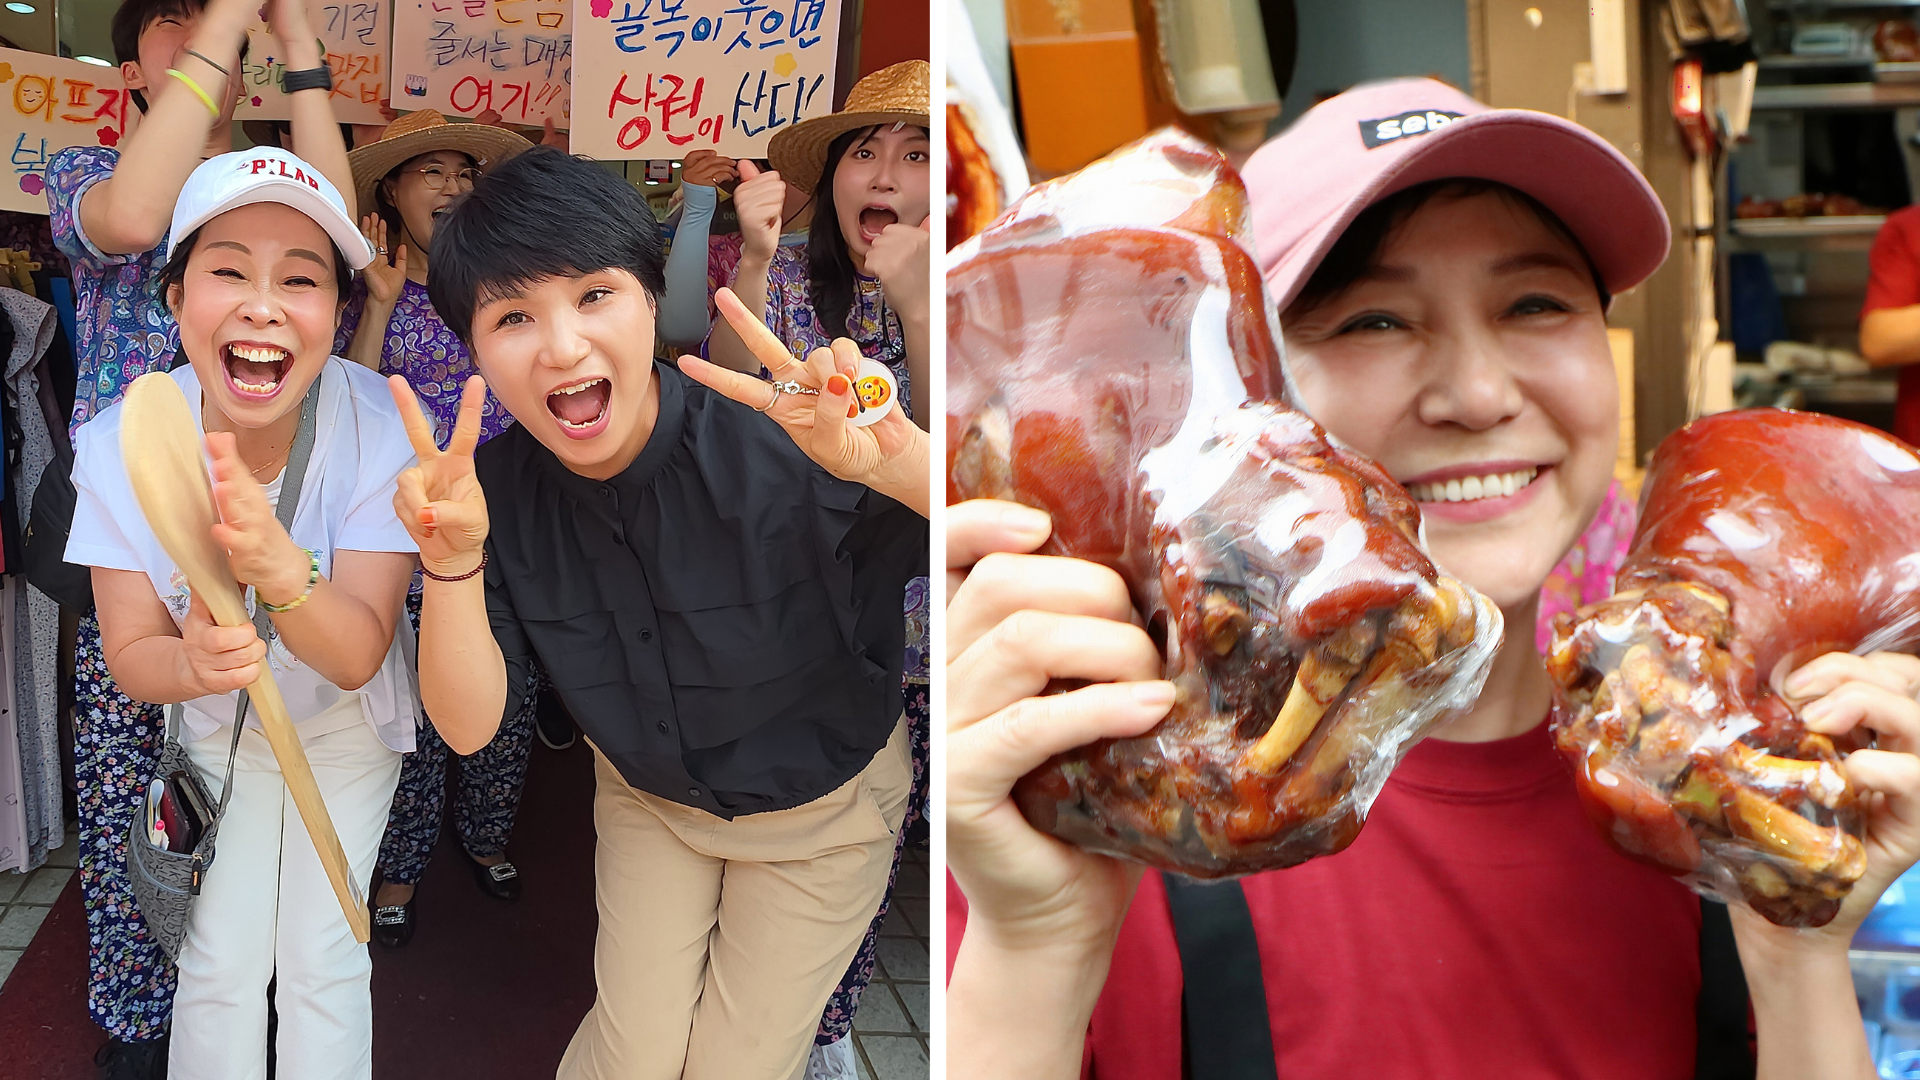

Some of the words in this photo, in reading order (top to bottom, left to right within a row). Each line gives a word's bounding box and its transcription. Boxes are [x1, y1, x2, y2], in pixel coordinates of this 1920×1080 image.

[324, 2, 378, 46] 기절
[429, 20, 511, 68] 줄서는
[327, 53, 381, 104] 맛집
[450, 76, 562, 119] 여기!!
[15, 75, 130, 138] 아프지
[608, 73, 724, 150] 상권이
[1376, 111, 1462, 140] seb
